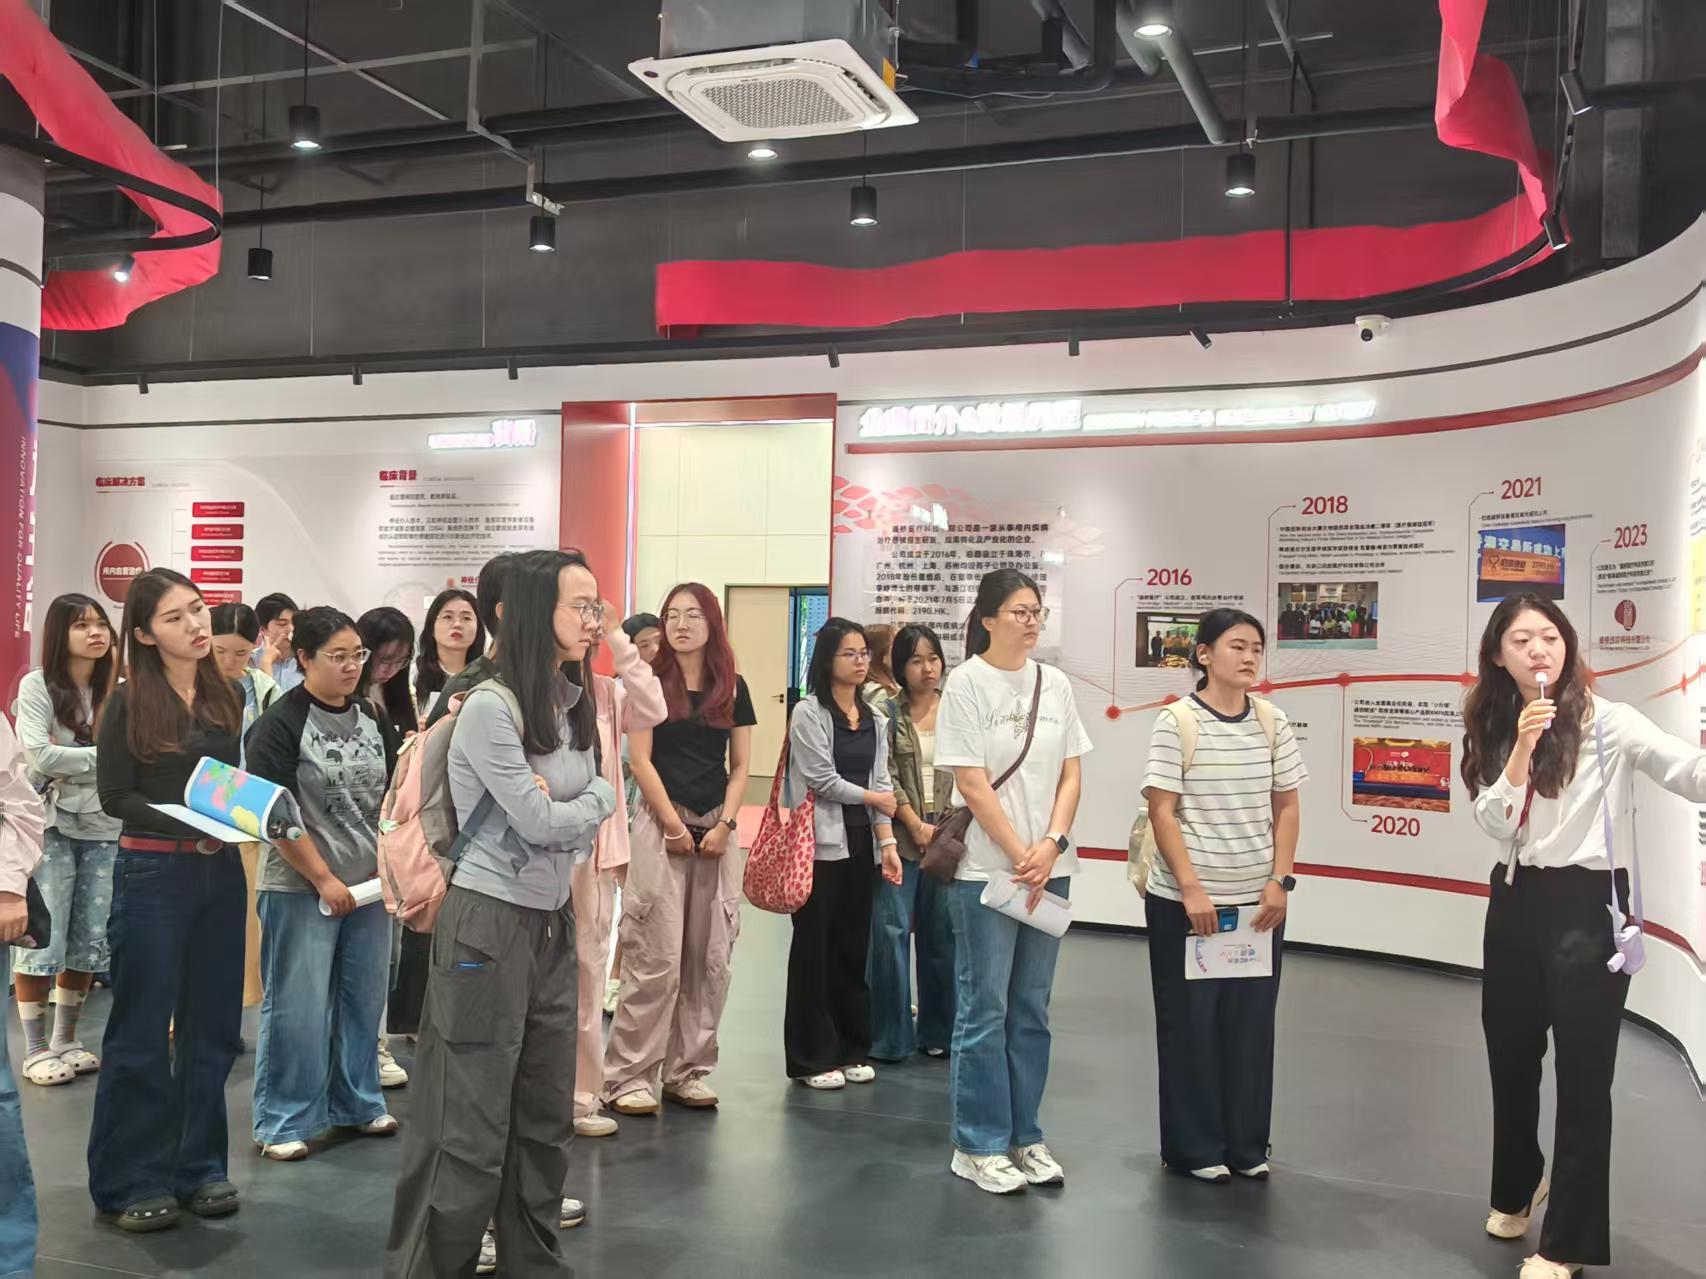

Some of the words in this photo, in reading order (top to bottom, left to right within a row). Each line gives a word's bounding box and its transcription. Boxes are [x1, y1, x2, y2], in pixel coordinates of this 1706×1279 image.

[18, 436, 26, 519] INNOVATION
[379, 470, 417, 481] 临床背景
[1501, 476, 1542, 500] 2021
[1302, 496, 1348, 515] 2018
[1613, 524, 1648, 549] 2023
[15, 551, 23, 609] QUALITY
[1147, 568, 1192, 586] 2016
[1371, 814, 1420, 837] 2020
